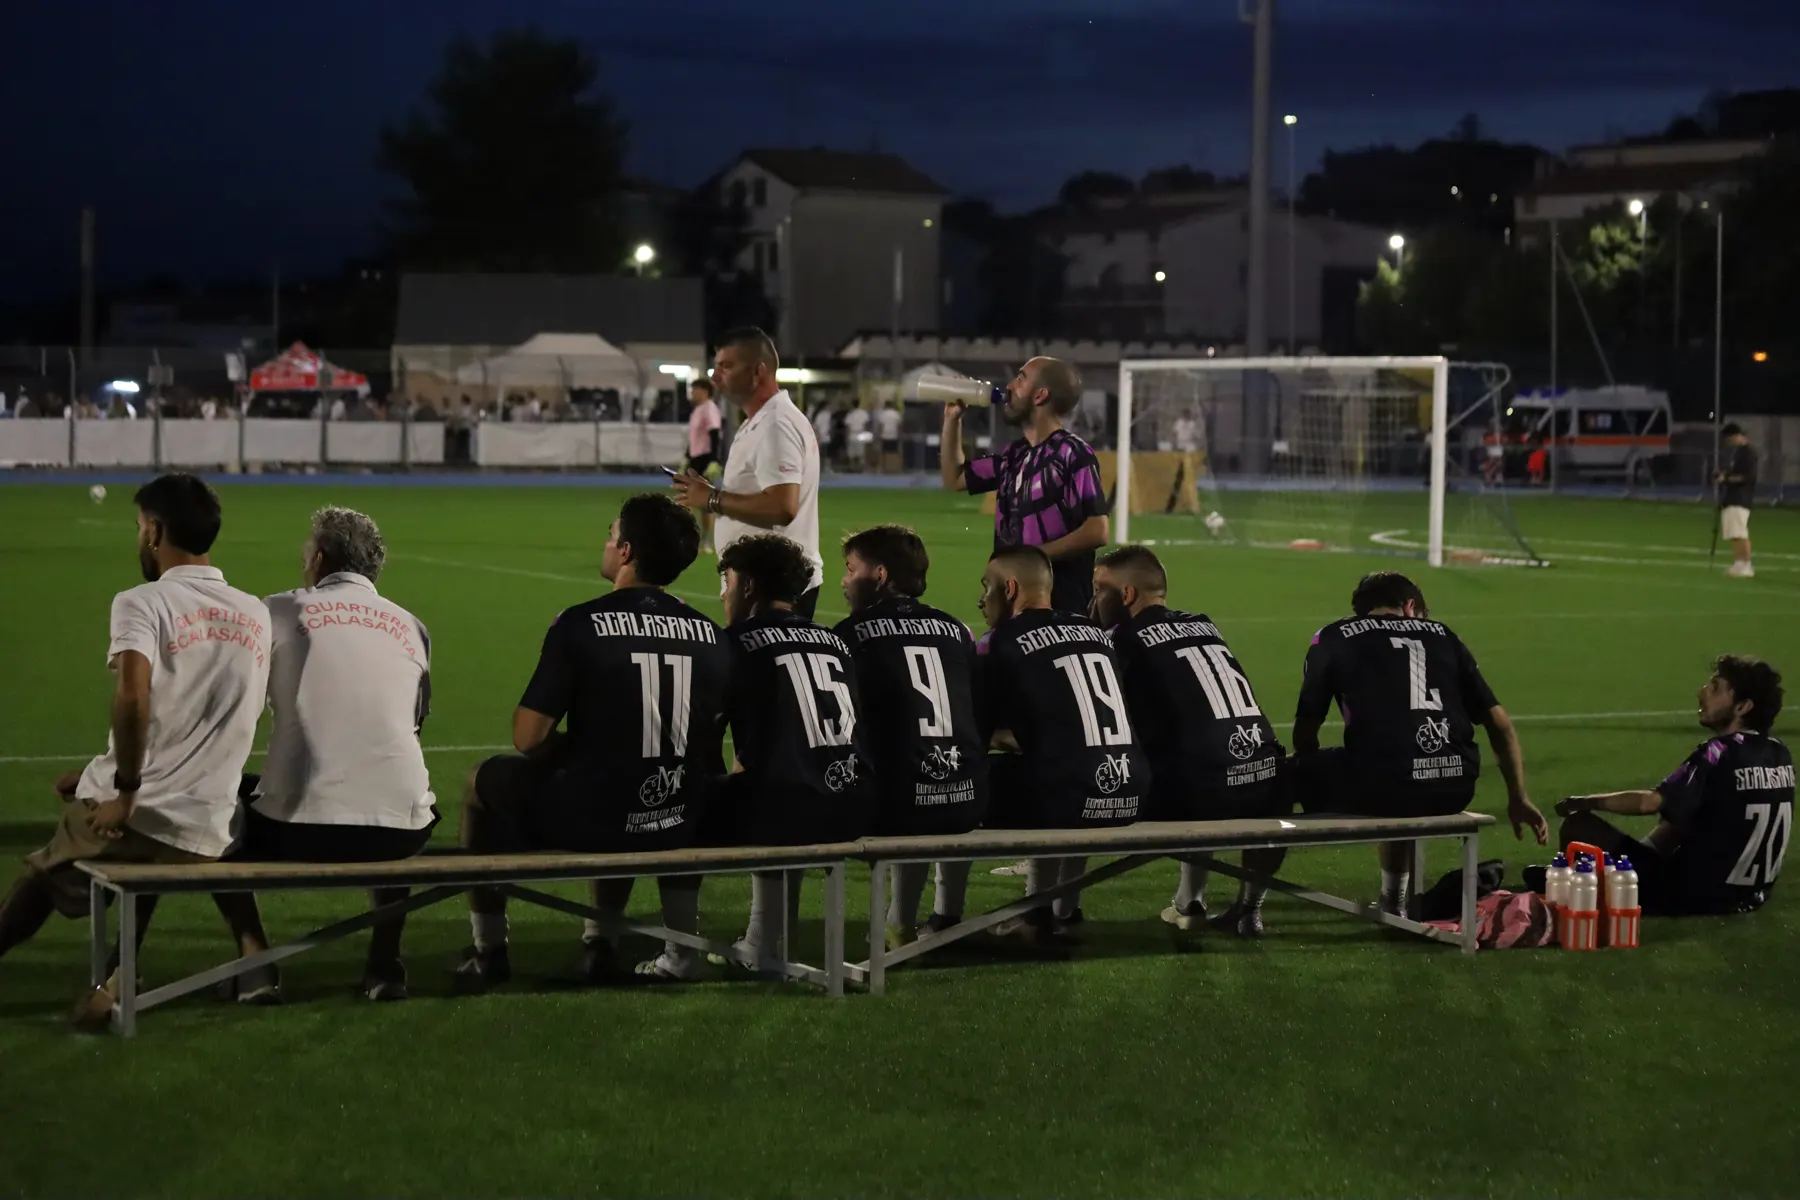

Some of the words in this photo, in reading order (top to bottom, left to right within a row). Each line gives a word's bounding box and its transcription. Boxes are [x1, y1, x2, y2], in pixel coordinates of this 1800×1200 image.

[166, 626, 265, 668] SCALASANTA
[175, 607, 264, 639] QUARTIERE
[296, 614, 416, 658] SCALASANTA
[304, 601, 411, 634] QUARTIERE
[590, 611, 718, 645] SCALASANTA
[853, 618, 963, 643] SCALASANTA
[1339, 617, 1447, 639] SCALASANTA
[774, 652, 857, 749] 15
[902, 645, 954, 738] 9
[1052, 652, 1133, 747] 19
[1174, 643, 1262, 720] 16
[1389, 636, 1444, 711] 2
[630, 652, 694, 760] 11
[1725, 801, 1793, 887] 20
